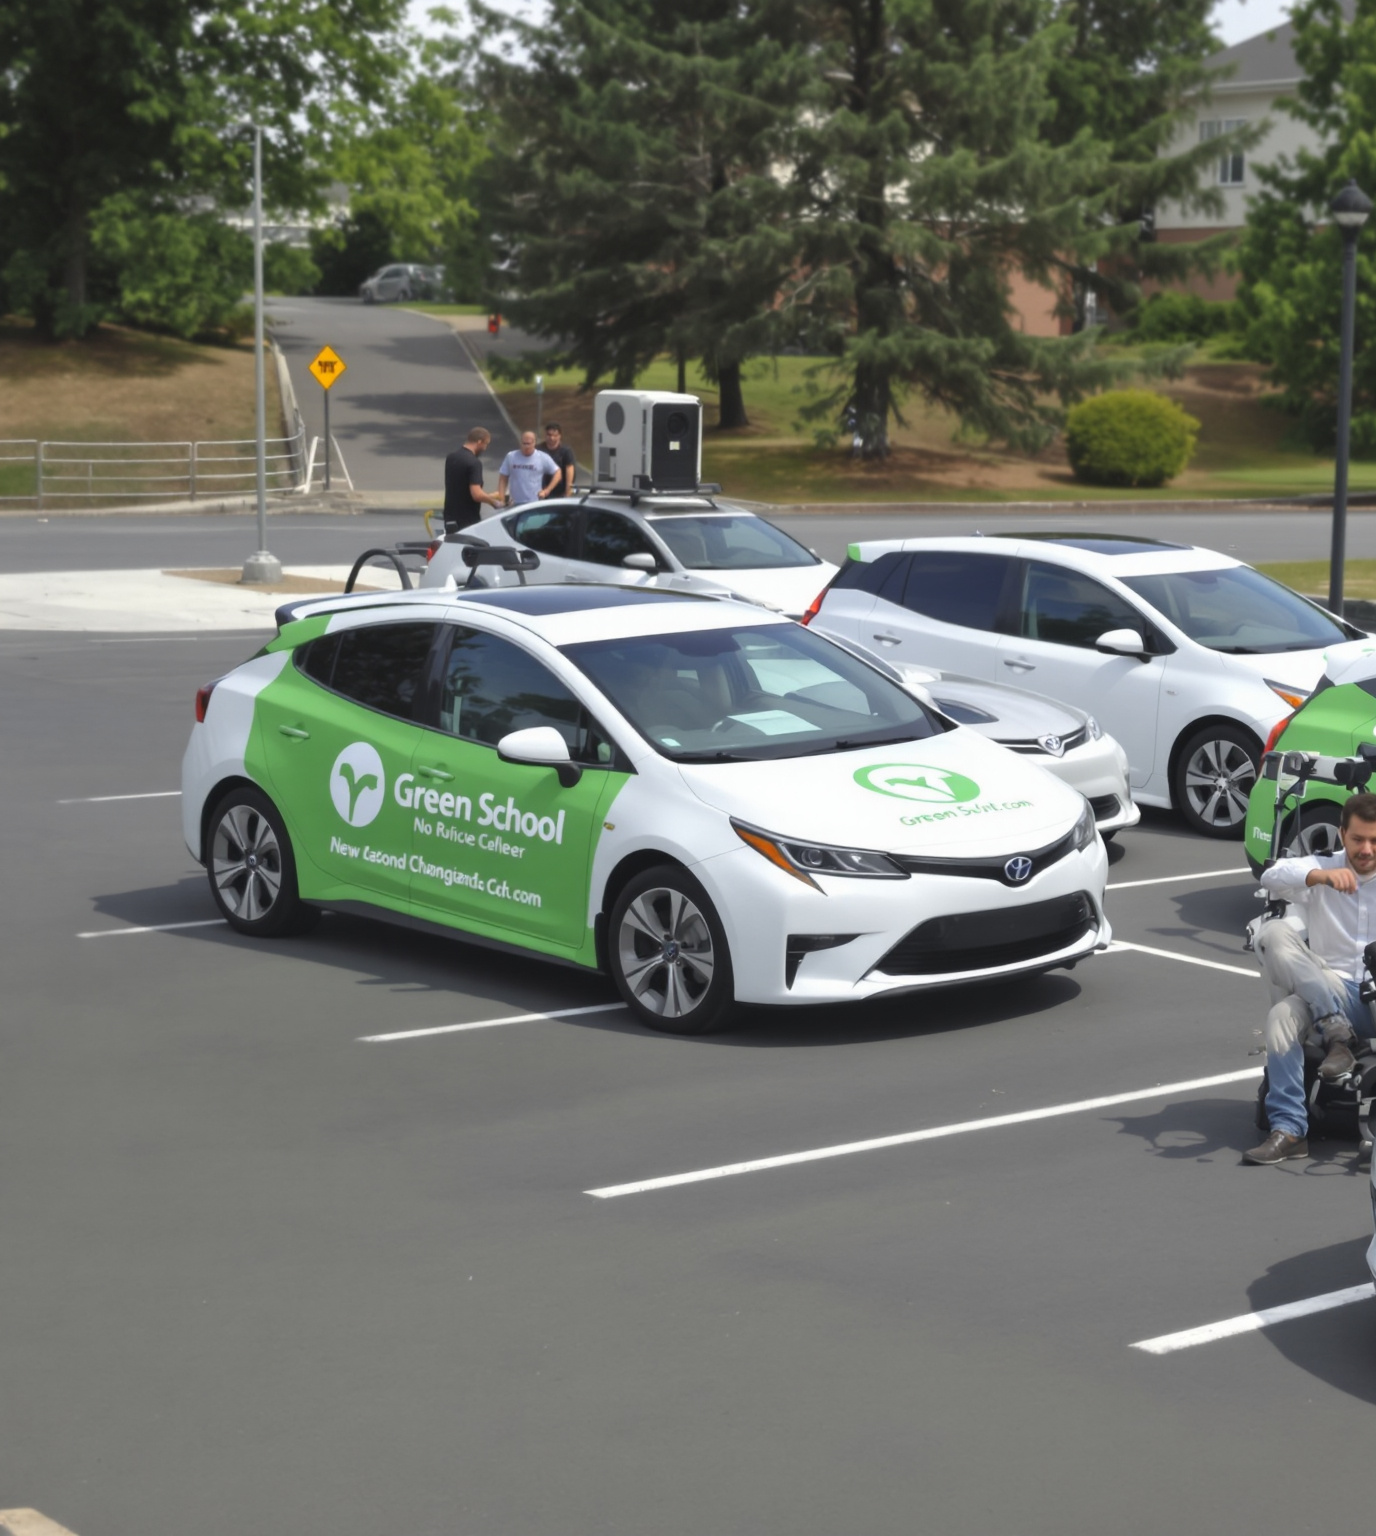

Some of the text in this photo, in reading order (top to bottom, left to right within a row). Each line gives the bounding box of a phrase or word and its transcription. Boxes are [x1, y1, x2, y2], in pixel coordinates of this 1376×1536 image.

[394, 773, 565, 845] Green School
[414, 816, 432, 835] No
[330, 836, 360, 858] New
